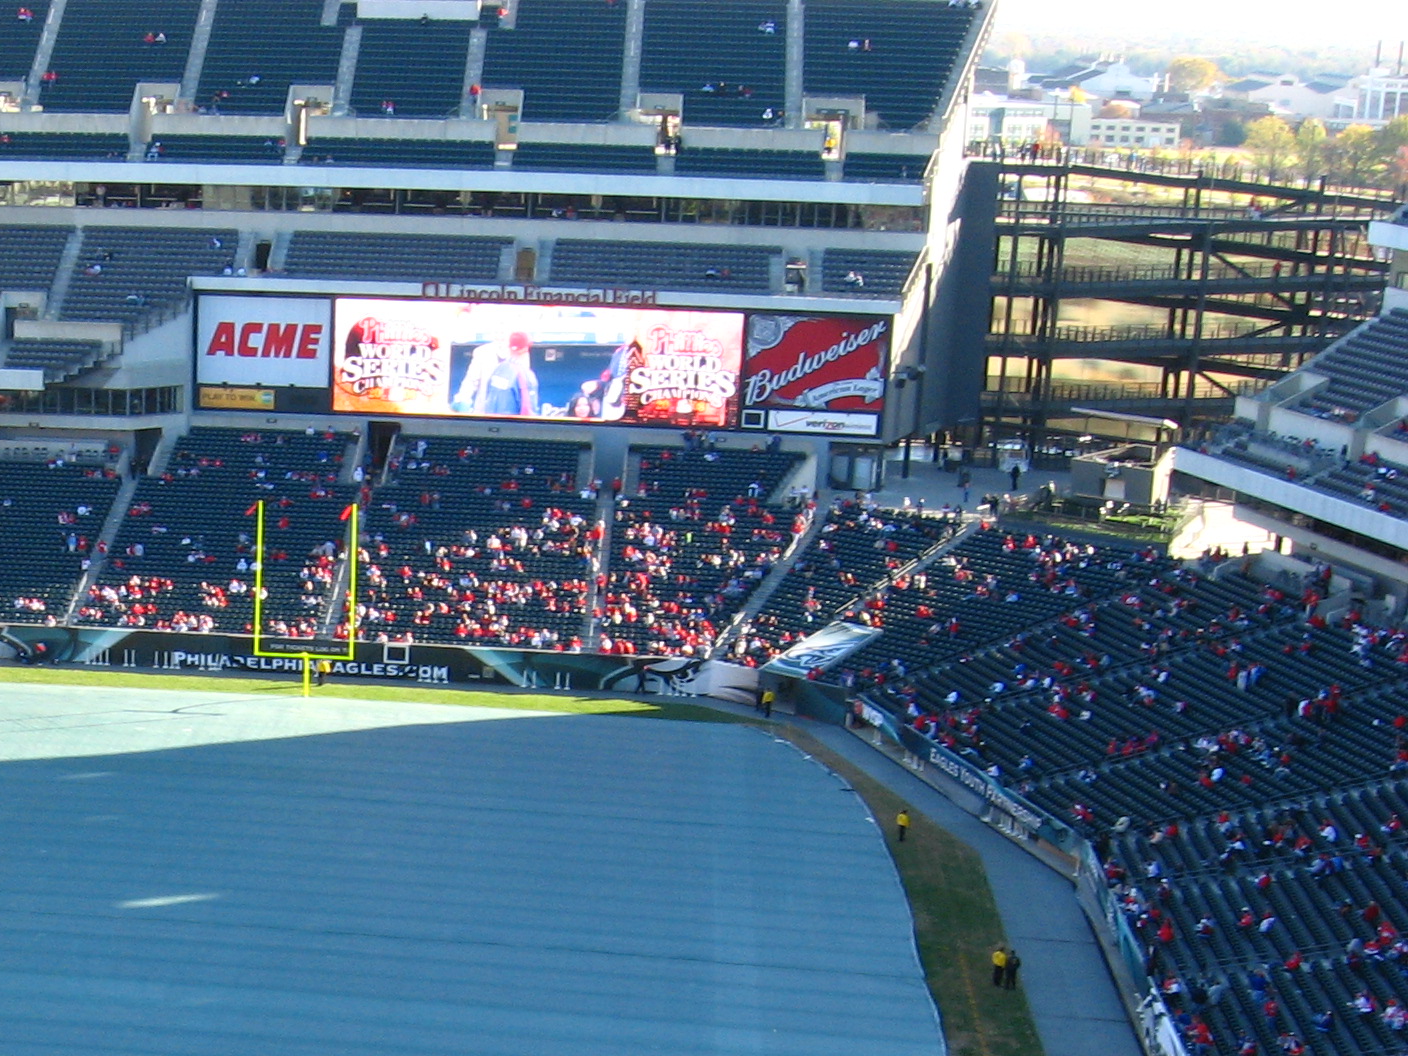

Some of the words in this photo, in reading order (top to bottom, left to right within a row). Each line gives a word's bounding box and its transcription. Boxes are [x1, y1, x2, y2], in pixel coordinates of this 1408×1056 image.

[446, 283, 518, 300] Lincoln
[524, 285, 606, 303] Financial
[613, 288, 656, 305] Field
[206, 321, 324, 360] ACME
[358, 341, 432, 362] WORLD
[342, 355, 443, 384] SERIES
[646, 353, 722, 373] WORLD
[744, 320, 887, 406] Budweiser
[630, 367, 736, 398] SERIES
[806, 419, 846, 431] verizon
